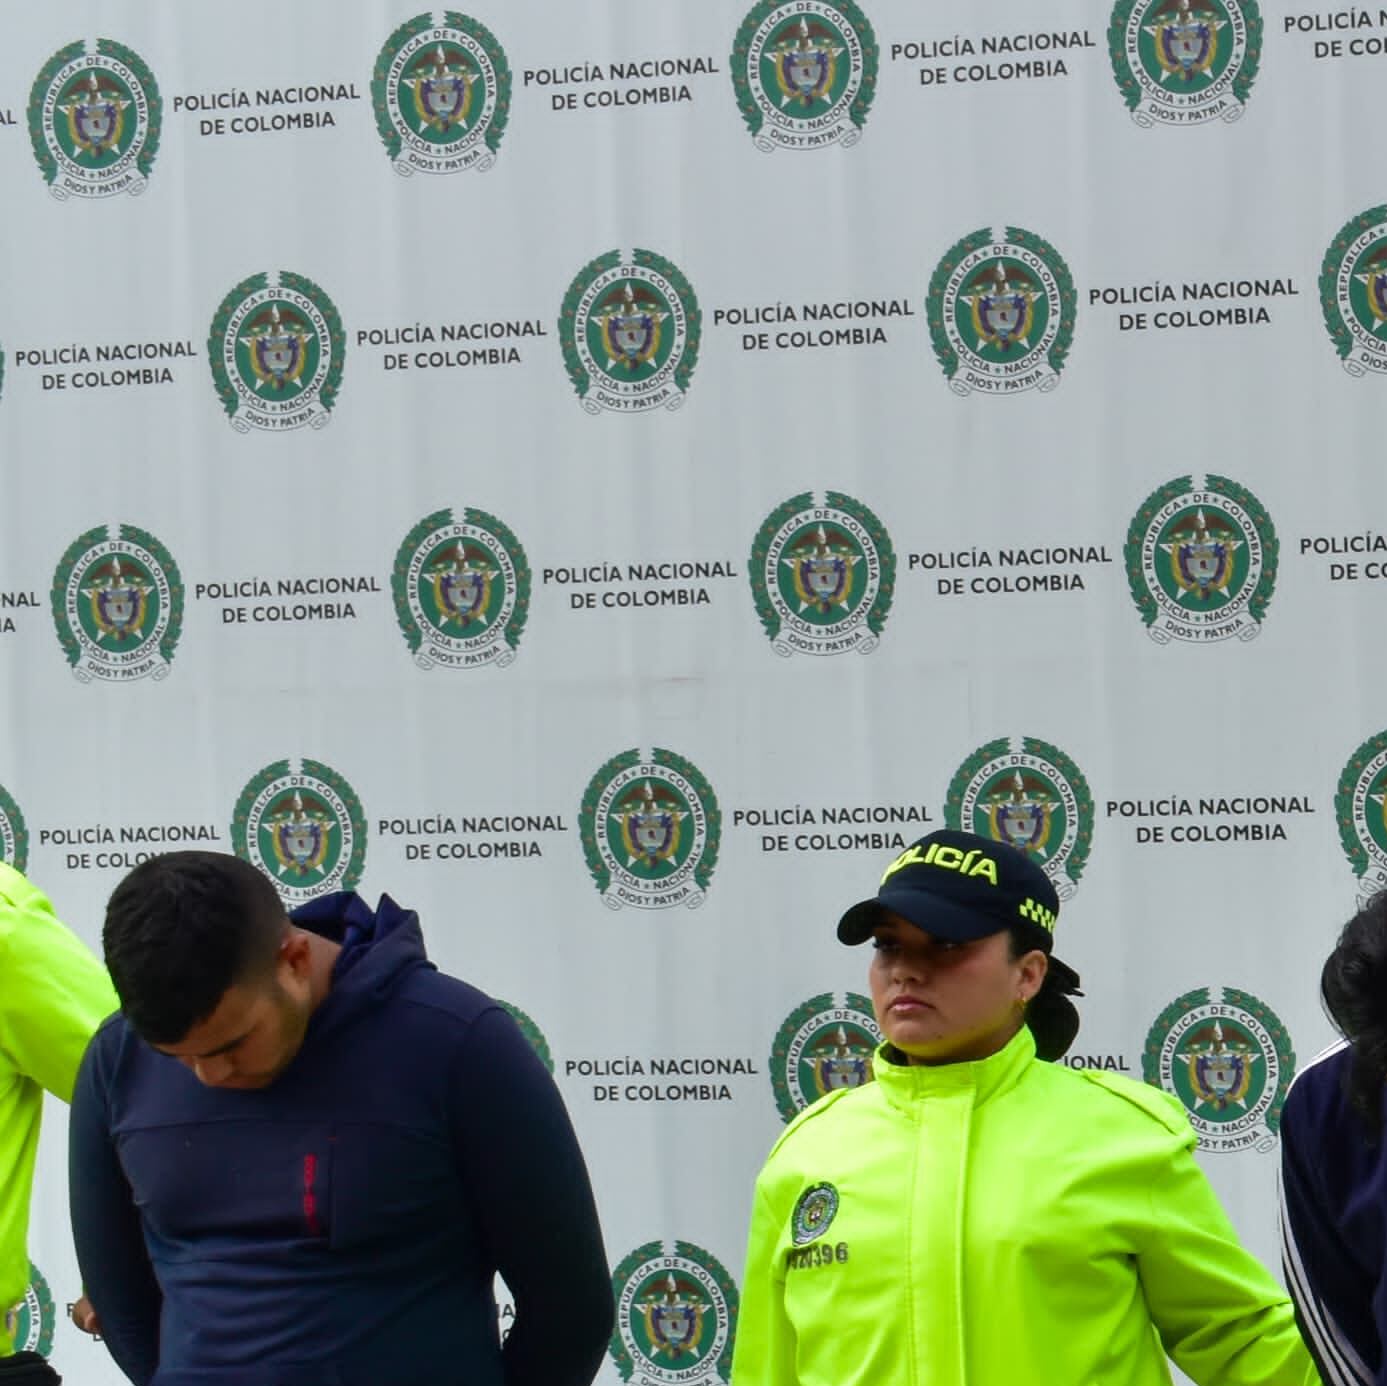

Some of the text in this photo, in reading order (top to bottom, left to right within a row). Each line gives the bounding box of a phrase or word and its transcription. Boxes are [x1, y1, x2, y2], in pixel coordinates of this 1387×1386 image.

[1284, 7, 1373, 33] POLICÍA
[891, 30, 1097, 61] POLICÍA NACIONAL
[1314, 39, 1343, 59] DE
[523, 56, 720, 87] POLICÍA NACIONAL
[919, 59, 1068, 86] DE COLOMBIA
[173, 83, 361, 113] POLICÍA NACIONAL
[551, 84, 693, 111] DE COLOMBIA
[199, 111, 336, 137] DE COLOMBIA
[1089, 278, 1300, 306] POLICÍA NACIONAL
[713, 299, 915, 326] POLICÍA NACIONAL
[1119, 306, 1271, 331] DE COLOMBIA
[742, 327, 888, 351] DE COLOMBIA
[15, 340, 198, 367] POLICÍA NACIONAL
[41, 367, 174, 391] DE COLOMBIA
[908, 545, 1113, 571] POLICÍA NACIONAL
[543, 561, 738, 585] POLICÍA NACIONAL
[1330, 563, 1359, 581] DE
[195, 576, 382, 600] POLICÍA NACIONAL
[937, 573, 1085, 596] DE COLOMBIA
[570, 588, 711, 609] DE COLOMBIA
[222, 602, 357, 624] DE COLOMBIA
[733, 804, 933, 827] POLICÍA NACIONAL
[1106, 794, 1316, 817] POLICÍA NACIONAL
[39, 823, 221, 846] POLICÍA NACIONAL
[378, 813, 569, 836] POLICÍA NACIONAL
[1136, 823, 1288, 844] DE COLOMBIA
[405, 841, 543, 861] DE COLOMBIA
[761, 832, 907, 853] DE COLOMBIA
[66, 853, 91, 870] DE
[564, 1055, 760, 1077] POLICÍA NACIONAL
[1063, 1055, 1131, 1071] IONAL
[593, 1084, 733, 1102] DE COLOMBIA
